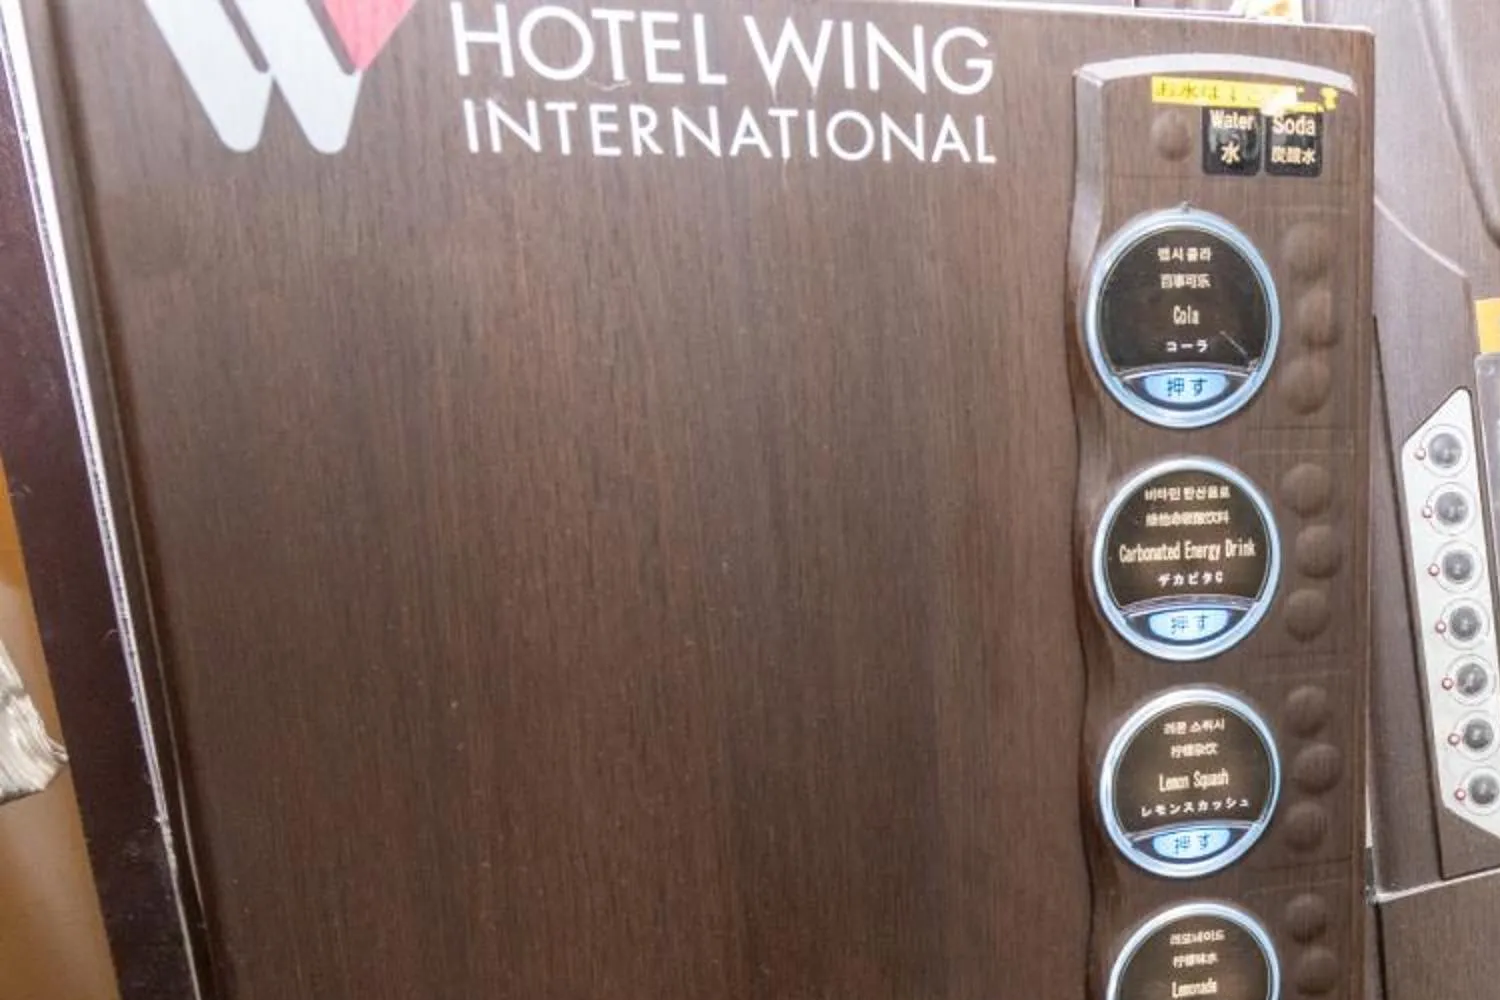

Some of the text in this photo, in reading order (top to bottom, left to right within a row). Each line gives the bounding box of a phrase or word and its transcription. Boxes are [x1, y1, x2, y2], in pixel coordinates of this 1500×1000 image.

[450, 1, 994, 96] HOTEL WING
[1210, 109, 1254, 131] Water
[1272, 115, 1317, 136] Soda
[463, 98, 997, 164] INTERNATIONAL
[1221, 142, 1240, 165] 水
[1172, 304, 1200, 325] Cola
[1165, 339, 1209, 353] コーラ
[1166, 377, 1209, 397] 押す
[1119, 537, 1256, 563] Carbonated Energy Drink
[1159, 773, 1190, 793] Lemon
[1140, 797, 1250, 818] レモンスカッシュ
